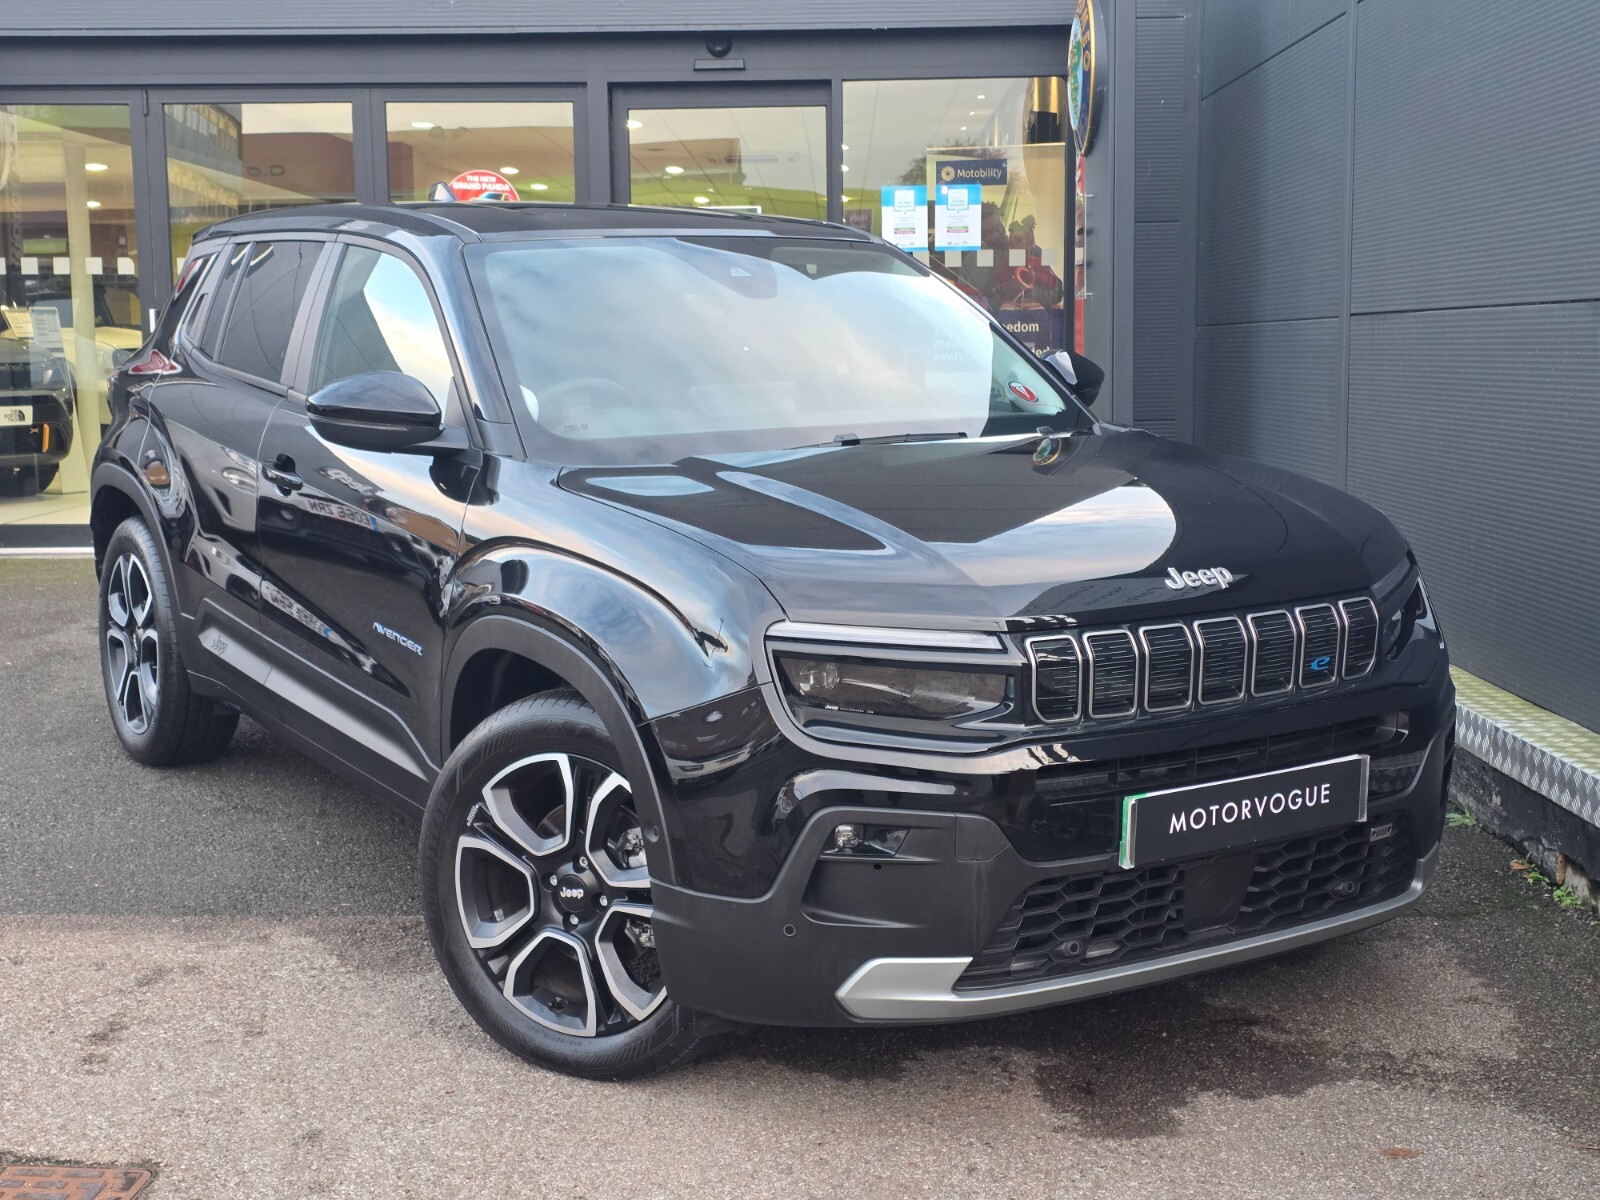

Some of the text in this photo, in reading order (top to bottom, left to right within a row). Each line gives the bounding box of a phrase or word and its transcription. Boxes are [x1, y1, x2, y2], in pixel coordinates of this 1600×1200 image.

[957, 167, 1002, 180] Motability
[452, 181, 510, 191] GRAND PANDA
[1165, 567, 1234, 590] Jeep
[372, 621, 423, 656] AVENGER
[1168, 783, 1331, 835] MOTORVOGUE
[560, 886, 584, 899] Jeep
